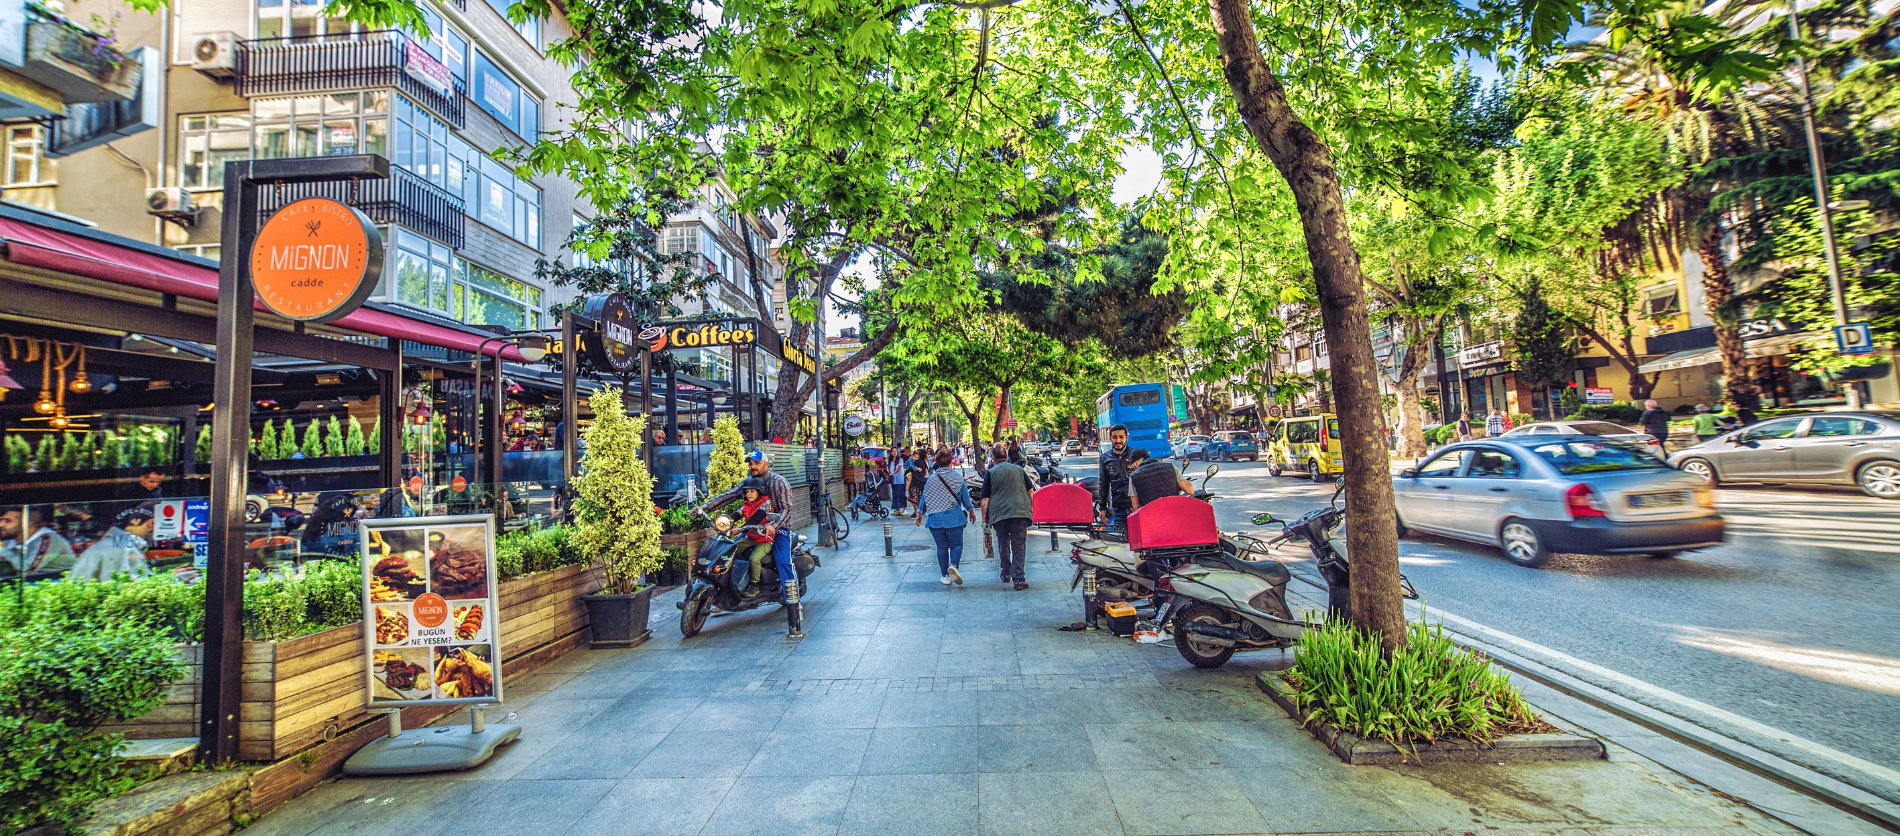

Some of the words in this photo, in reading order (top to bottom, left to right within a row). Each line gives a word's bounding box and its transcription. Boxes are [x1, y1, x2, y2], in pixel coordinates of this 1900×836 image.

[281, 204, 308, 221] CAFE
[322, 204, 353, 226] BISTRO
[270, 244, 349, 270] MiGNON
[291, 278, 323, 287] cadde
[263, 282, 350, 312] RESTAURANT
[671, 324, 754, 347] Coffees
[1738, 319, 1788, 337] ESA
[1843, 328, 1861, 345] D
[605, 348, 633, 368] RESTAURANT
[784, 336, 803, 367] Gloria
[803, 349, 816, 374] Jean
[195, 544, 207, 556] SE
[418, 628, 445, 636] BUGÜN
[424, 637, 452, 645] YESEM?
